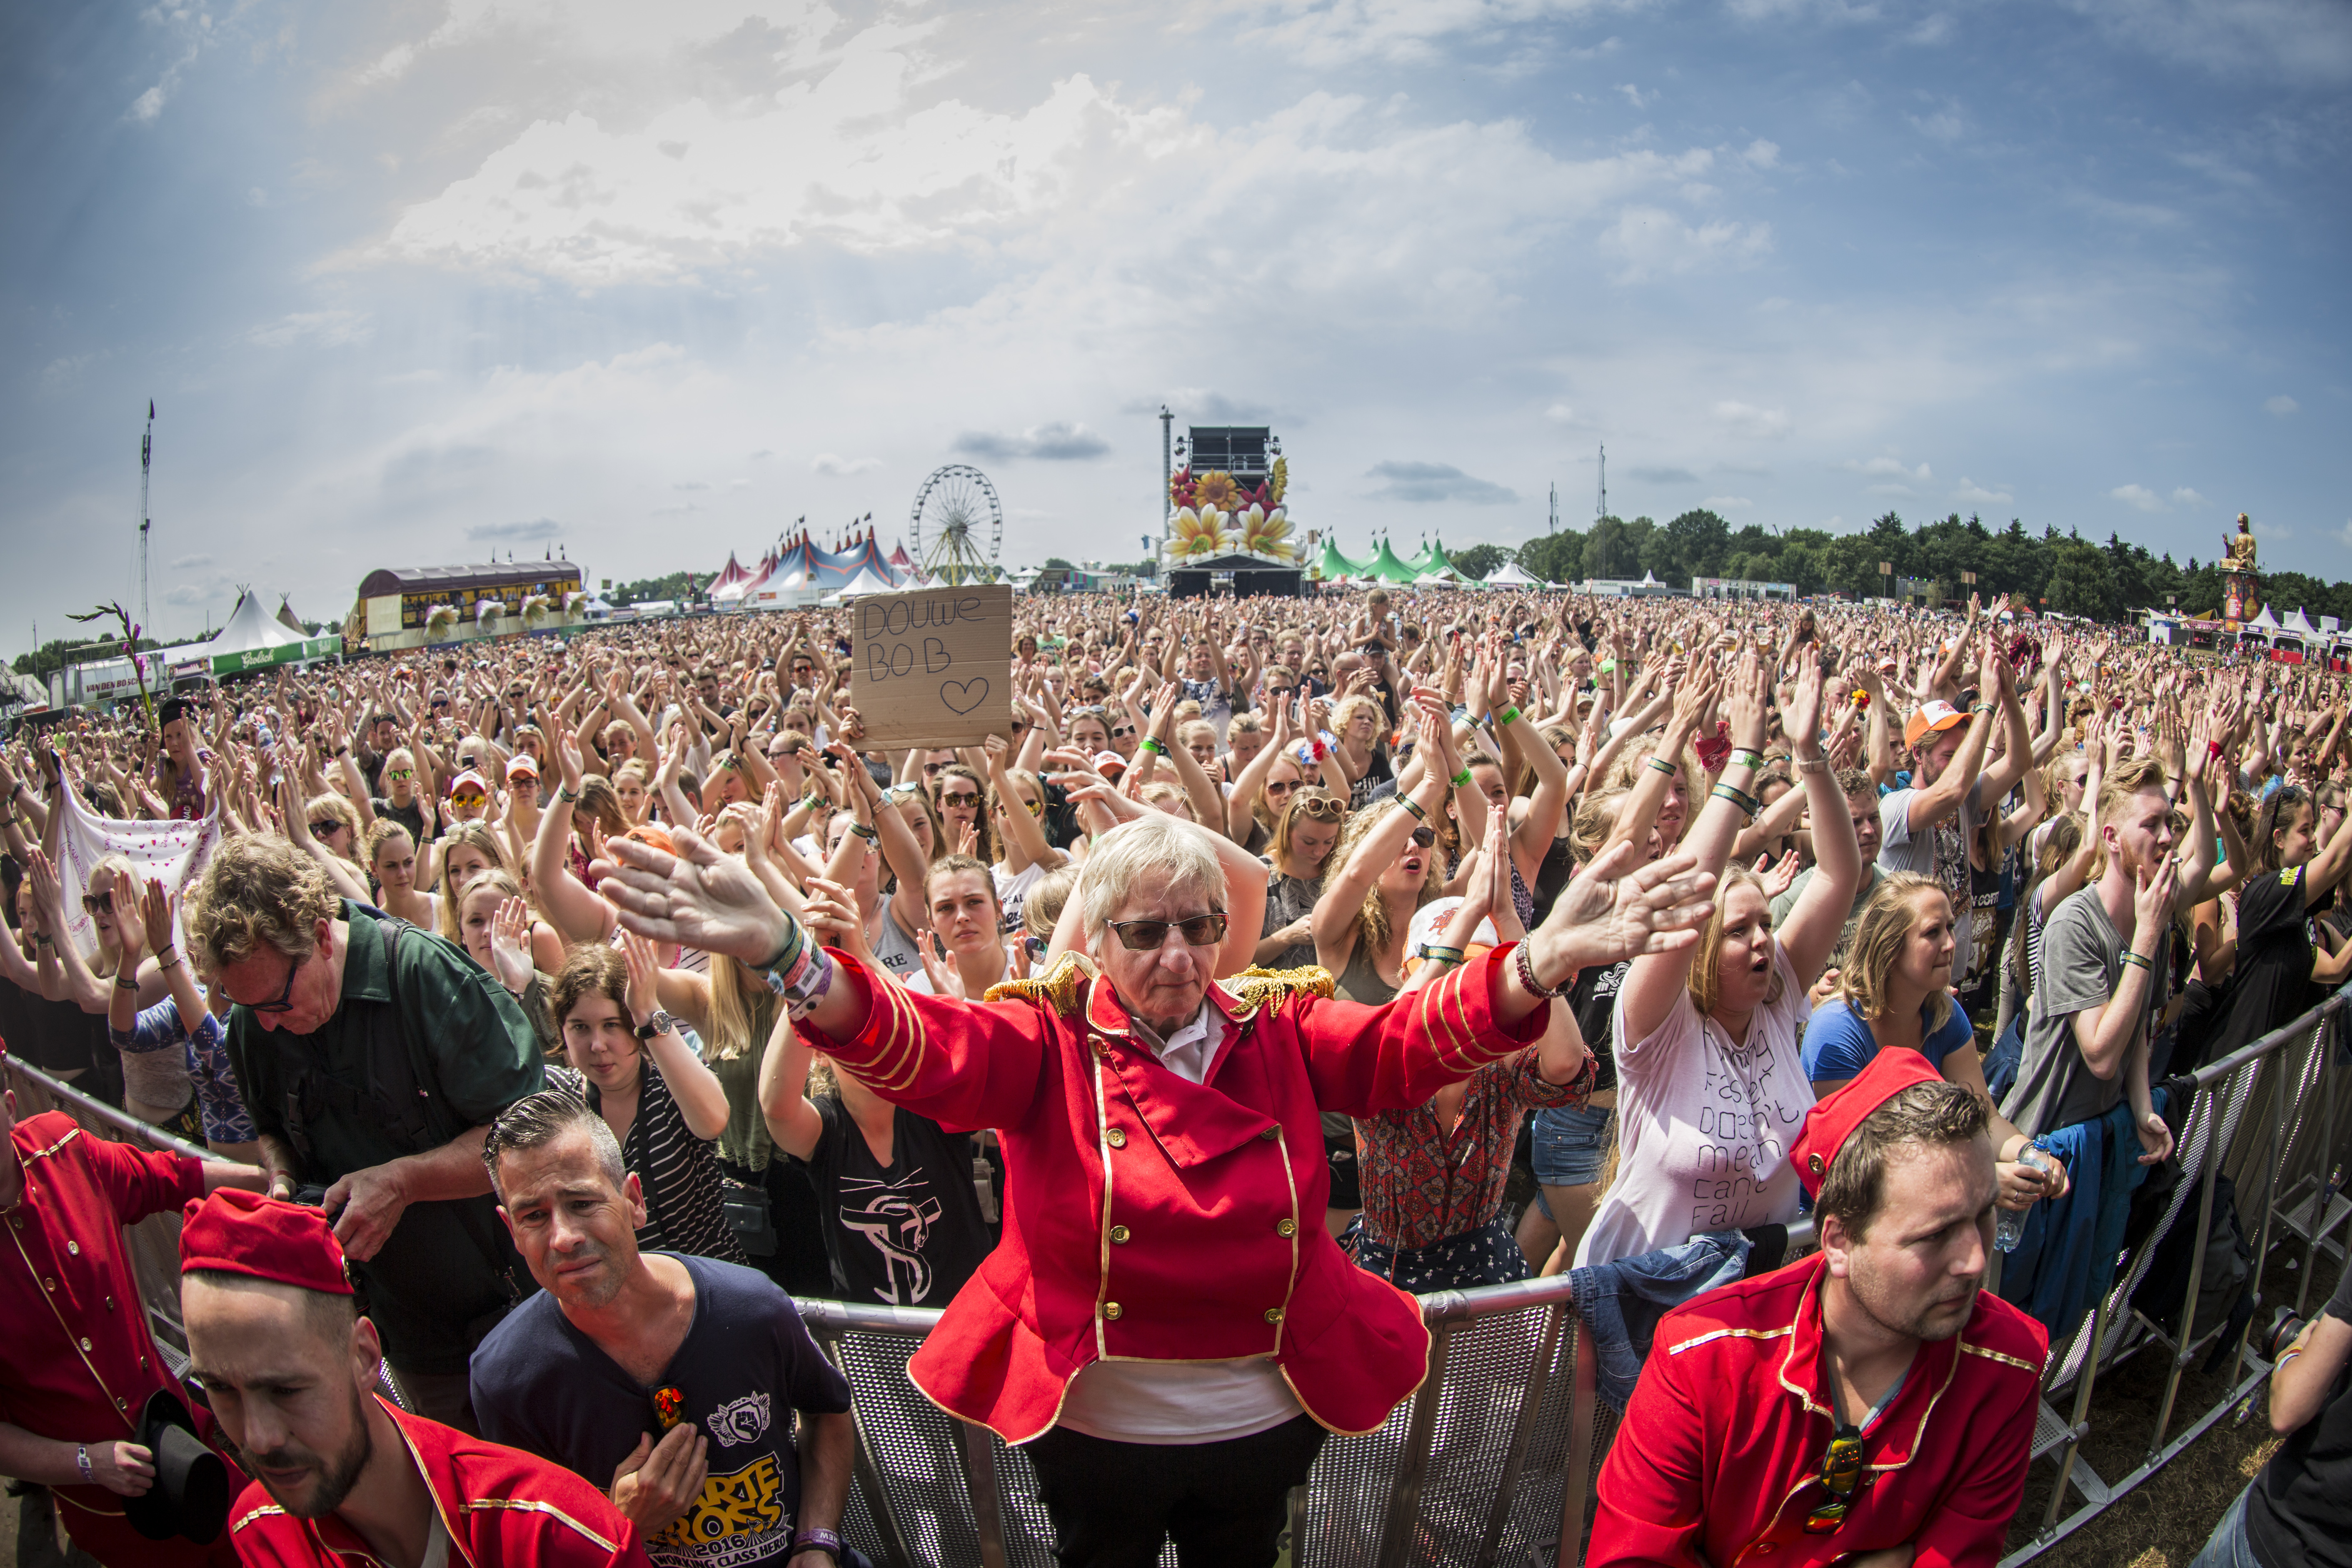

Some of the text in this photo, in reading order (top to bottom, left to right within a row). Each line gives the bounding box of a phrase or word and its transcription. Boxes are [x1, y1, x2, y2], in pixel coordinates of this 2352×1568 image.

[241, 649, 275, 669] Grolsch
[868, 637, 951, 682] BOB
[86, 684, 100, 693] VAN
[101, 681, 115, 690] DEN
[1698, 1139, 1782, 1172] mean
[1691, 1199, 1749, 1227] Fall
[654, 1535, 786, 1568] WORKING CLASS HERO
[692, 1533, 747, 1557] 2016
